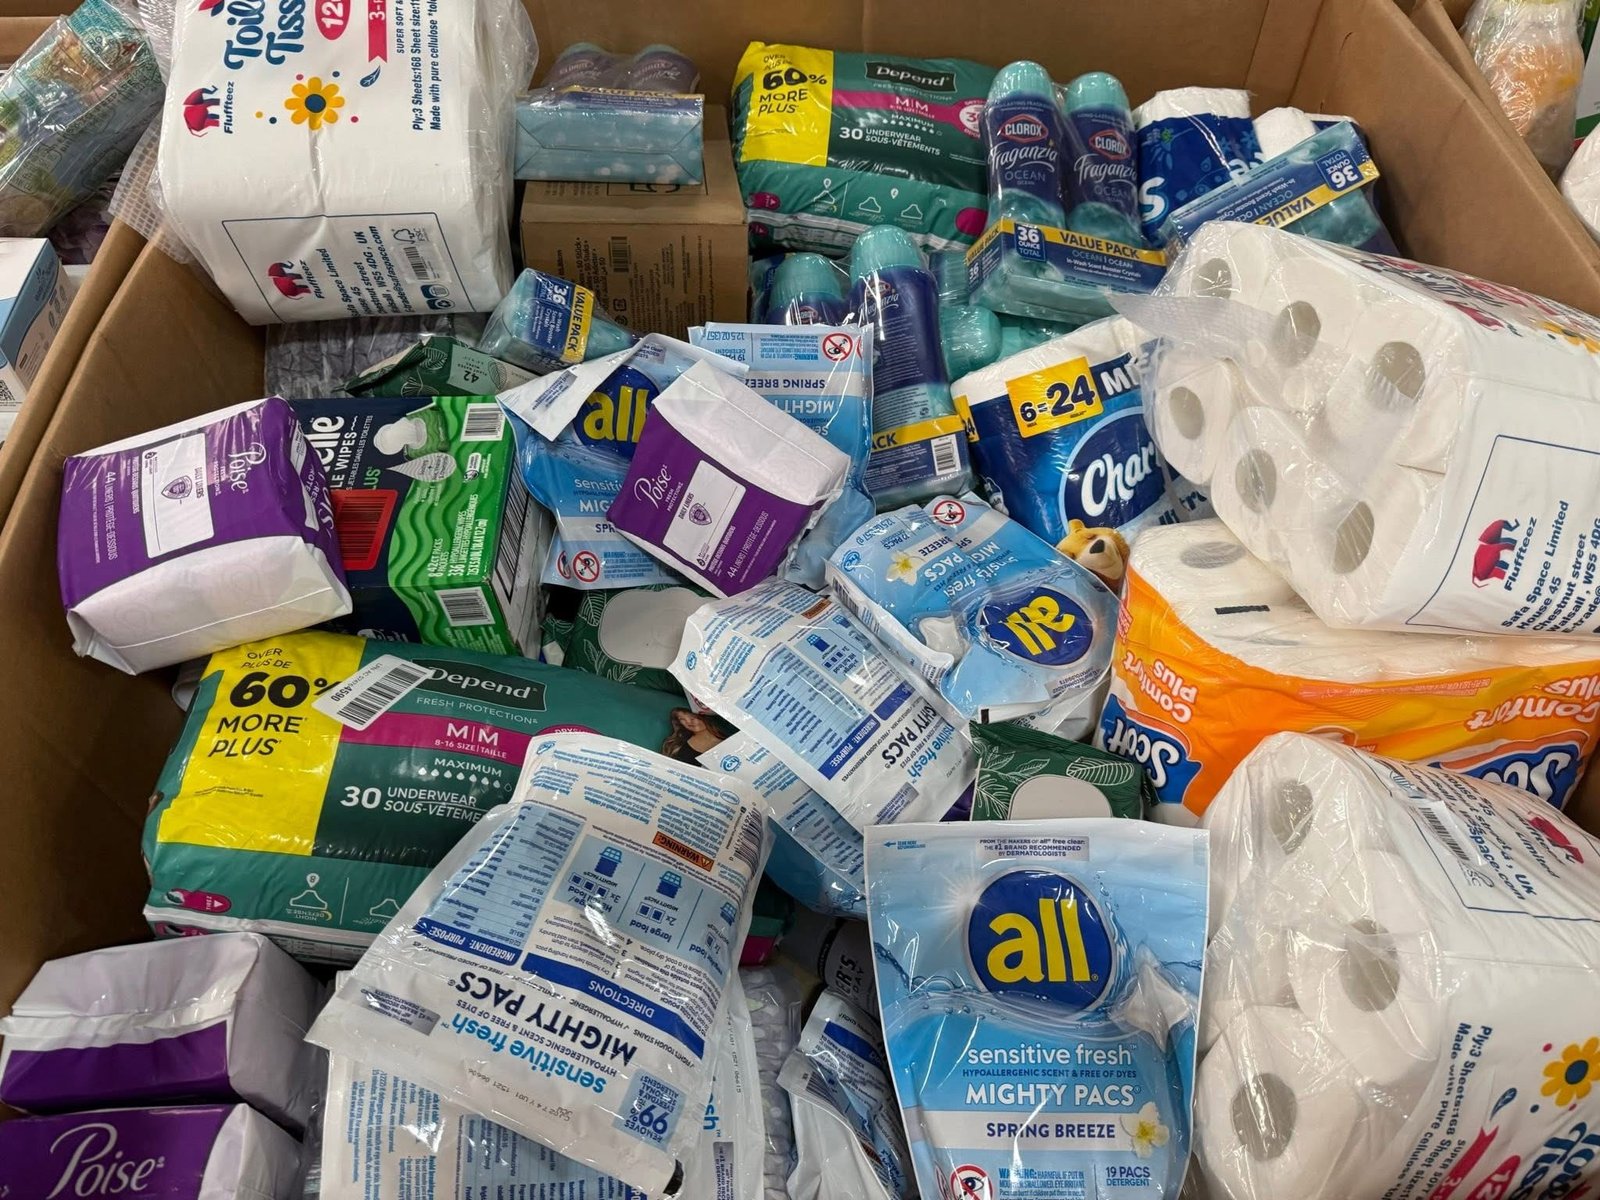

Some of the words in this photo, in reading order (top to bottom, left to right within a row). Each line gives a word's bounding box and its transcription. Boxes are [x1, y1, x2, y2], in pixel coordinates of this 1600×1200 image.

[397, 27, 405, 54] SUPER
[411, 28, 422, 53] Sheet
[431, 19, 440, 59] cellulose
[430, 59, 440, 82] pure
[762, 68, 828, 91] 60%
[876, 64, 951, 87] Depend
[429, 83, 440, 106] with
[759, 89, 809, 103] MORE
[224, 81, 235, 135] Fluffteez
[429, 107, 441, 131] Made
[758, 104, 798, 117] PLUS
[891, 113, 934, 128] MAXIMUM
[1005, 123, 1042, 138] CLOROX
[839, 127, 864, 140] 30
[865, 128, 922, 142] UNDERWEAR
[865, 134, 941, 156] SOUS-VÊTEMENTS
[1095, 137, 1127, 153] CLOROX
[988, 142, 1058, 175] Fraganzia
[1073, 153, 1138, 186] Fraganzia
[1322, 152, 1347, 167] TOTAL
[1326, 158, 1351, 175] OUNCE
[1004, 170, 1046, 182] OCEAN
[1331, 165, 1359, 190] 36
[1258, 189, 1294, 213] OCEAN
[353, 231, 368, 244] UK
[1017, 226, 1040, 243] 36
[1018, 241, 1041, 250] OUNCE
[1060, 231, 1104, 250] VALUE
[1106, 241, 1140, 259] PACK
[316, 248, 341, 279] Limited
[363, 251, 379, 271] 4DG
[1018, 247, 1042, 258] TOTAL
[1072, 249, 1101, 263] OCEAN
[1107, 256, 1133, 269] OCEAN
[353, 261, 372, 287] street
[552, 284, 567, 306] 36
[571, 291, 588, 324] VALUE
[566, 325, 581, 353] PACK
[782, 379, 826, 389] SPRING
[582, 386, 649, 444] all
[335, 431, 358, 471] WIPES
[105, 471, 117, 484] 44
[227, 442, 267, 492] Poise
[106, 483, 118, 504] LINERS
[634, 467, 672, 510] Poise
[106, 506, 119, 561] PROTÈGE-DESSOUS
[727, 566, 738, 578] 44
[736, 550, 747, 571] LINERS
[1501, 605, 1531, 627] Safa
[1526, 560, 1552, 604] Space
[1544, 500, 1570, 558] Limited
[1504, 516, 1538, 592] Fluffteez
[925, 552, 965, 582] PACS
[1532, 581, 1577, 632] Chestnut
[1571, 533, 1588, 580] street
[1546, 596, 1588, 633] Walsall
[1582, 553, 1599, 585] WS5
[1517, 597, 1553, 630] House
[1548, 576, 1562, 595] 45
[1005, 595, 1076, 656] all
[240, 658, 272, 670] PLUS
[273, 659, 292, 669] DE
[247, 648, 283, 660] OVER
[428, 666, 530, 699] Depend
[416, 696, 455, 709] FRESH
[459, 702, 534, 725] PROTECTION
[216, 714, 303, 734] MORE
[207, 737, 279, 758] PLUS
[434, 739, 454, 748] 8-16
[829, 743, 854, 768] PURPOSE:
[881, 727, 919, 766] PACS
[1107, 718, 1180, 788] Scott
[434, 757, 503, 778] MAXIMUM
[841, 755, 868, 782] PRESERVATIVES
[906, 747, 938, 778] fresh
[340, 785, 381, 809] 30
[387, 786, 477, 808] UNDERWEAR
[657, 835, 700, 862] WARNING:
[1514, 872, 1538, 896] UK
[629, 918, 650, 933] load
[664, 915, 677, 926] 2x
[430, 925, 467, 947] PURPOSE:
[650, 928, 672, 943] large
[986, 897, 1091, 983] all
[468, 937, 516, 963] INGREDIENT:
[548, 947, 567, 962] handling
[689, 943, 708, 958] load
[457, 957, 480, 970] ADDED
[456, 971, 526, 1017] PACS
[588, 979, 655, 1018] DIRECTIONS
[456, 999, 478, 1017] DYES
[477, 1008, 491, 1021] OF
[568, 999, 626, 1031] HYPOALLERGENIC
[452, 1012, 508, 1054] fresh
[491, 1014, 512, 1031] FREE
[517, 1027, 548, 1046] SCENT
[525, 1002, 638, 1068] MIGHTY
[632, 1028, 655, 1044] STAINS
[1450, 1022, 1472, 1060] Made
[1469, 1025, 1493, 1058] Ply:3
[547, 1037, 618, 1078] HYPOALLERGENIC
[653, 1039, 676, 1056] TOUGH
[968, 1043, 1070, 1065] sensitive
[1075, 1043, 1132, 1066] fresh
[510, 1037, 607, 1094] sensitive
[962, 1068, 1039, 1077] HYPOALLERGENIC
[1041, 1069, 1069, 1078] SCENT
[1071, 1070, 1078, 1078] &
[1080, 1070, 1101, 1079] FREE
[1102, 1070, 1114, 1079] OF
[1115, 1070, 1137, 1079] DYES
[965, 1083, 1068, 1106] MIGHTY
[1073, 1084, 1135, 1107] PACS
[1446, 1060, 1476, 1135] Sheets:168
[1430, 1098, 1450, 1131] pure
[987, 1122, 1050, 1139] SPRING
[1055, 1123, 1116, 1139] BREEZE
[47, 1123, 155, 1200] Poise
[1425, 1138, 1453, 1168] Sheet
[1443, 1138, 1466, 1171] SUPER
[1106, 1167, 1117, 1178] 19
[1119, 1166, 1151, 1178] PACS
[1106, 1178, 1150, 1188] DETERGENT
[1424, 1168, 1444, 1192] SOFT
